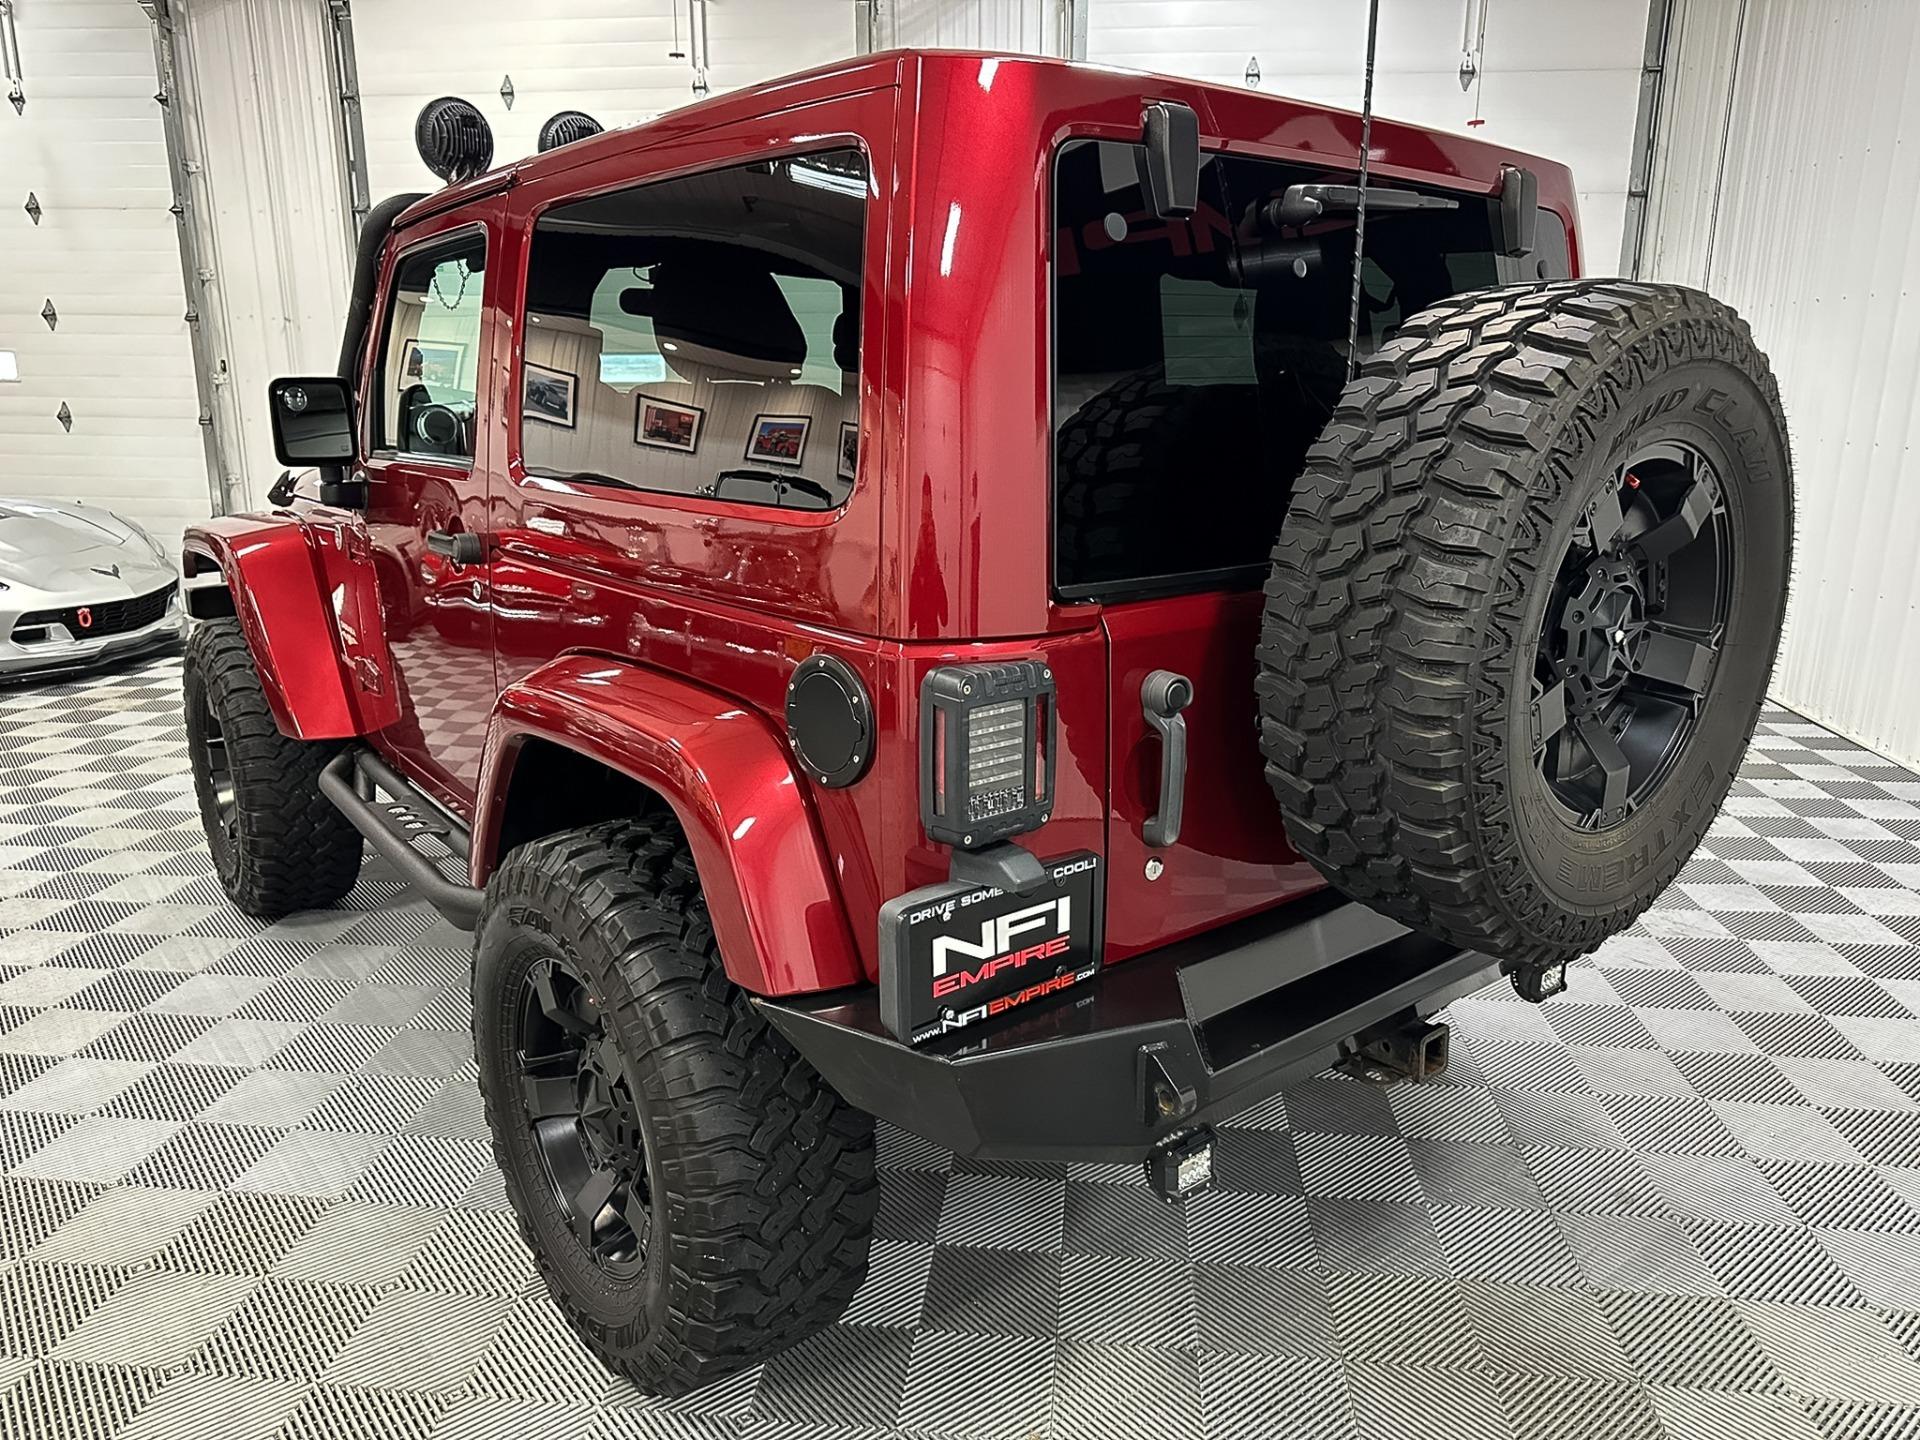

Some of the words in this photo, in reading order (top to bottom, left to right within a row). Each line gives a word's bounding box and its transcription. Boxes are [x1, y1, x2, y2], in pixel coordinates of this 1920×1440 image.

[1554, 760, 1716, 893] EXTREME
[910, 899, 956, 925] DRIVE
[960, 886, 1005, 907] SOME
[1053, 857, 1097, 879] COOL!
[932, 895, 1071, 978] NFI
[932, 934, 1071, 999] EMPIRE
